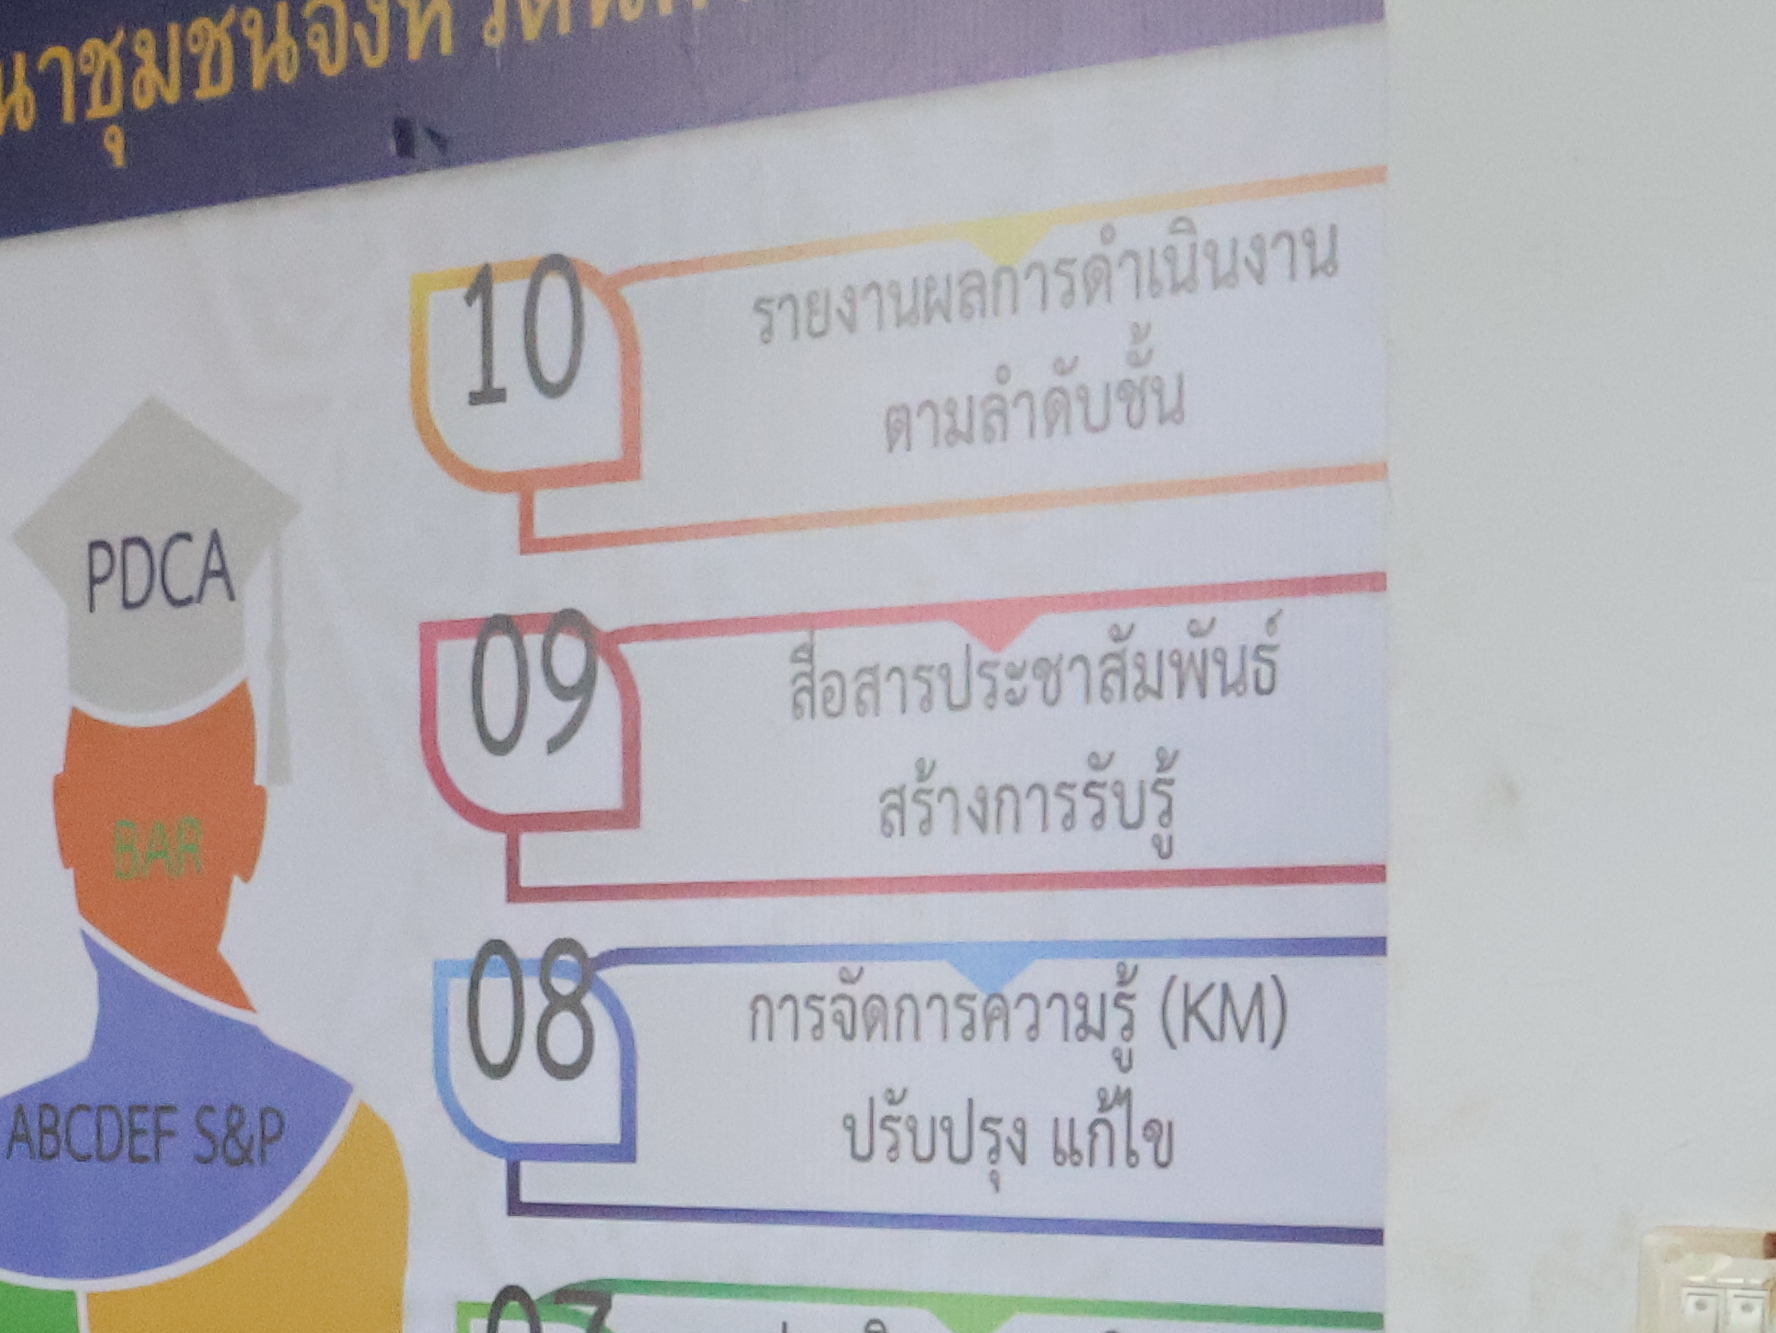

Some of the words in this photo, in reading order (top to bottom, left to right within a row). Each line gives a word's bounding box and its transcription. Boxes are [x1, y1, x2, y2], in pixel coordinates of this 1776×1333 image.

[463, 252, 585, 406] 10
[752, 217, 1341, 345] รายงานผลการดำเนินงาน
[884, 321, 1186, 454] ตามลำดับชั้น
[87, 527, 237, 614] PDCA
[470, 607, 599, 757] 09
[788, 608, 1285, 720] สื่อสารประชาสัมพันธ์
[113, 814, 204, 881] BAR
[878, 746, 1179, 861] สร้างการรับรู้
[467, 936, 596, 1081] 08
[748, 963, 1138, 1073] การจัดการความรู้
[1160, 971, 1289, 1051] (KM)
[6, 1102, 178, 1164] ABCDEF
[194, 1104, 286, 1167] S&P
[843, 1088, 1029, 1194] ปรับปรุง
[1053, 1086, 1176, 1169] แก้ไข
